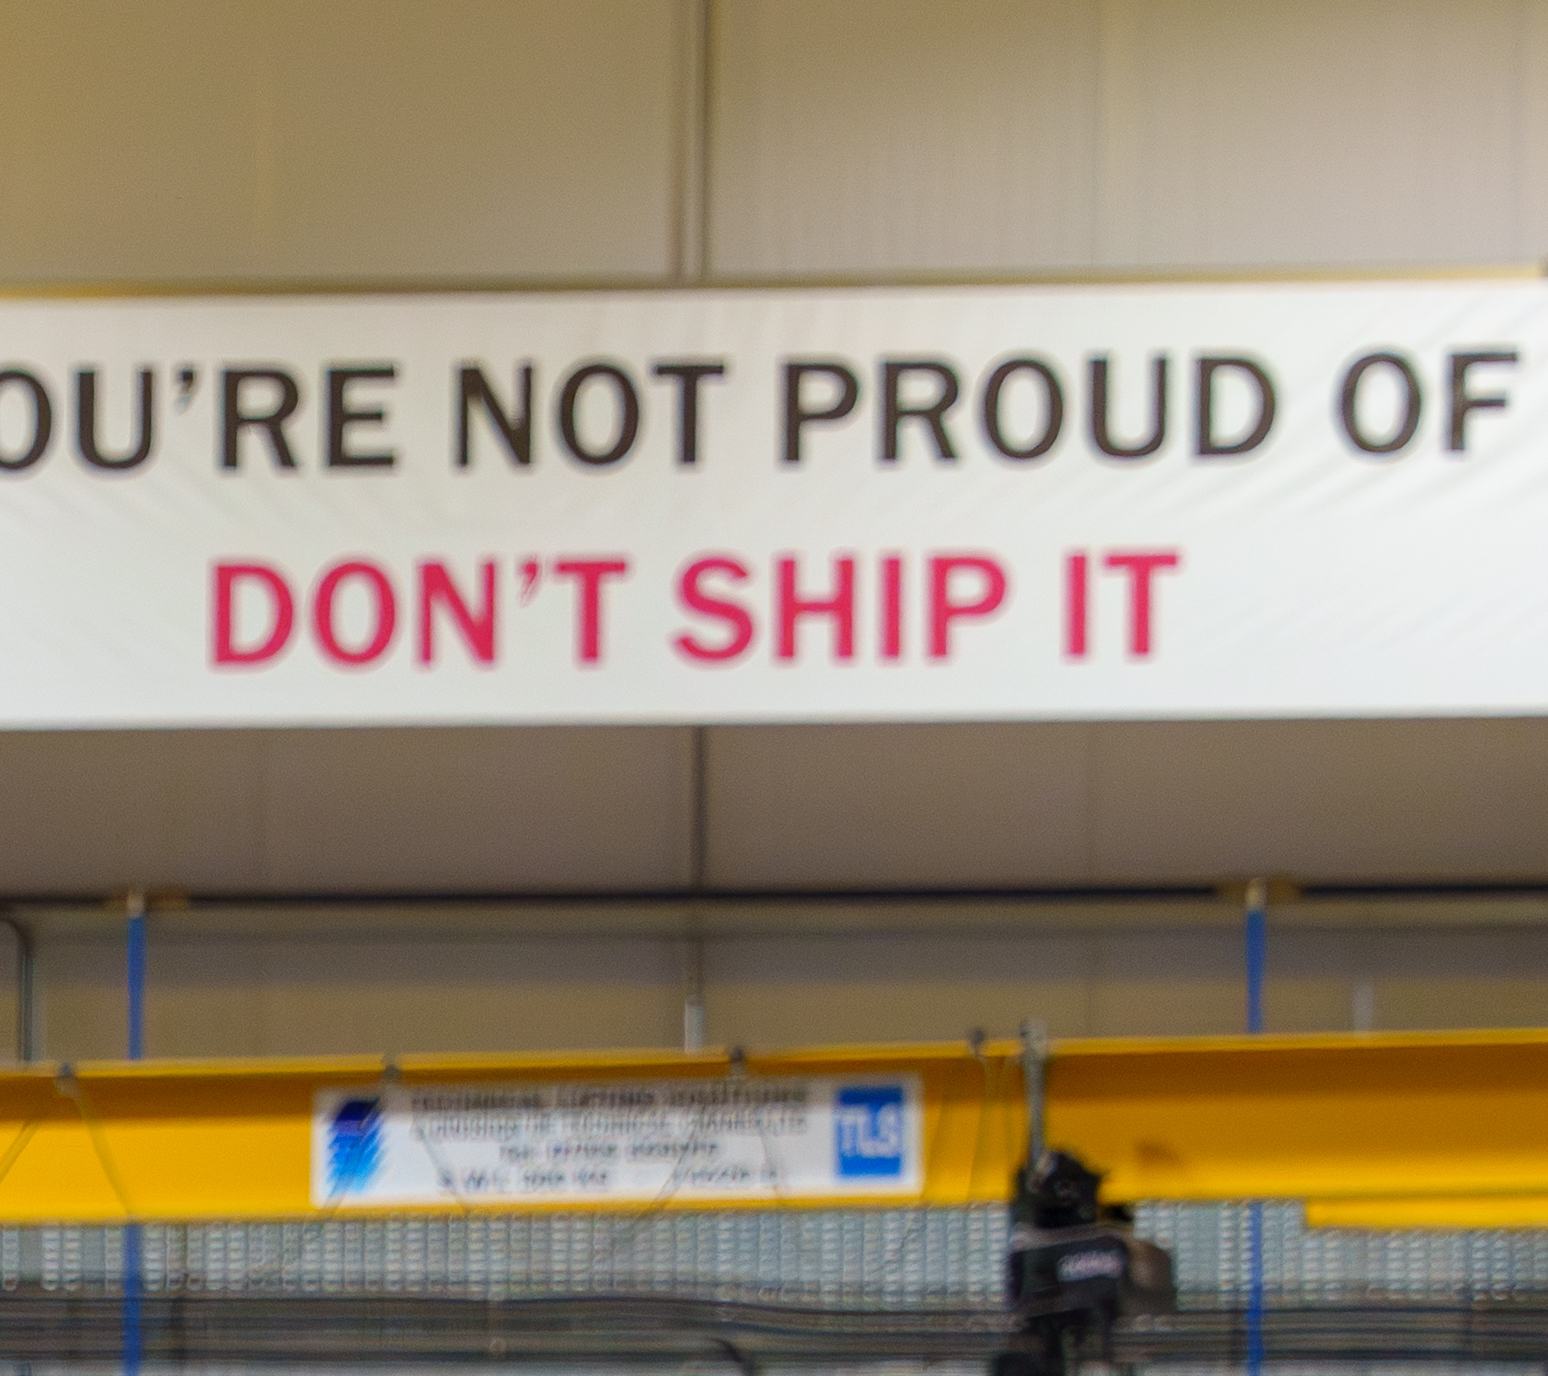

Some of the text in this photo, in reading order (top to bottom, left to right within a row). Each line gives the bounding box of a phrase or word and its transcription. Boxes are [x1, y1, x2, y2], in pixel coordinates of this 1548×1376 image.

[452, 358, 729, 470] NOT
[779, 355, 1279, 466] PROUD
[1336, 350, 1520, 456] OF
[211, 552, 1180, 668] DON'T SHIP IT
